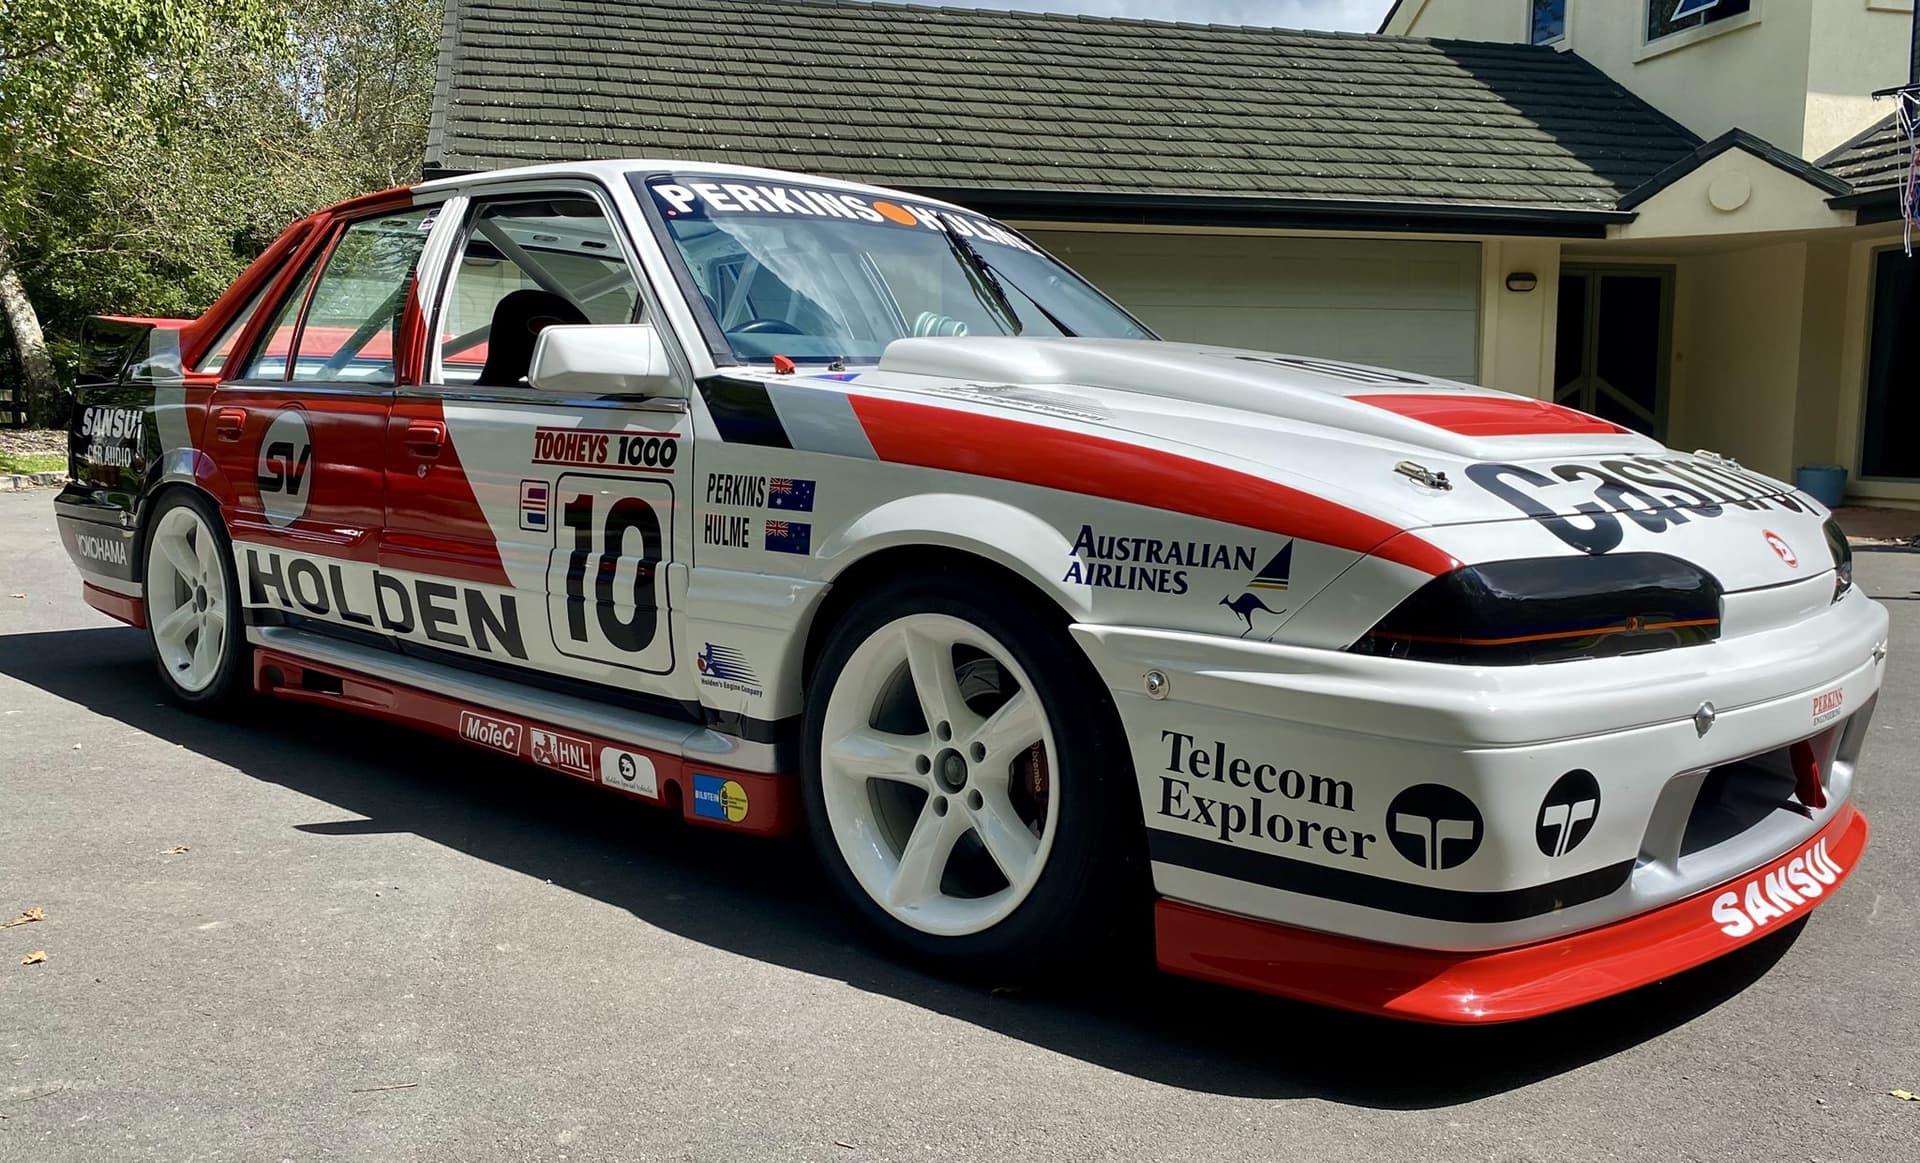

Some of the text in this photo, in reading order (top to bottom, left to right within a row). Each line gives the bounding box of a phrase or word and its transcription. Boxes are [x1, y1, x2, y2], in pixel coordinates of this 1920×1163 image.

[652, 183, 886, 223] PERKINS
[82, 407, 143, 440] SANSUI
[87, 444, 131, 468] CAR AUDIO
[258, 442, 310, 495] SV
[534, 432, 678, 468] TOOHEYS 1000
[706, 473, 766, 507] PERKINS
[704, 513, 750, 548] HULME
[1069, 524, 1257, 571] AUSTRALIAN
[76, 534, 128, 566] YOKOHAMA
[564, 493, 662, 653] 10
[1062, 561, 1189, 595] AIRLINES
[246, 549, 529, 660] HOLDEN
[465, 717, 515, 750] MoTeC
[559, 742, 590, 769] HNL
[1032, 751, 1042, 792] brembo
[1161, 729, 1356, 812] Telecom
[1157, 776, 1377, 860] Explorer
[1712, 837, 1842, 937] SANSUI
